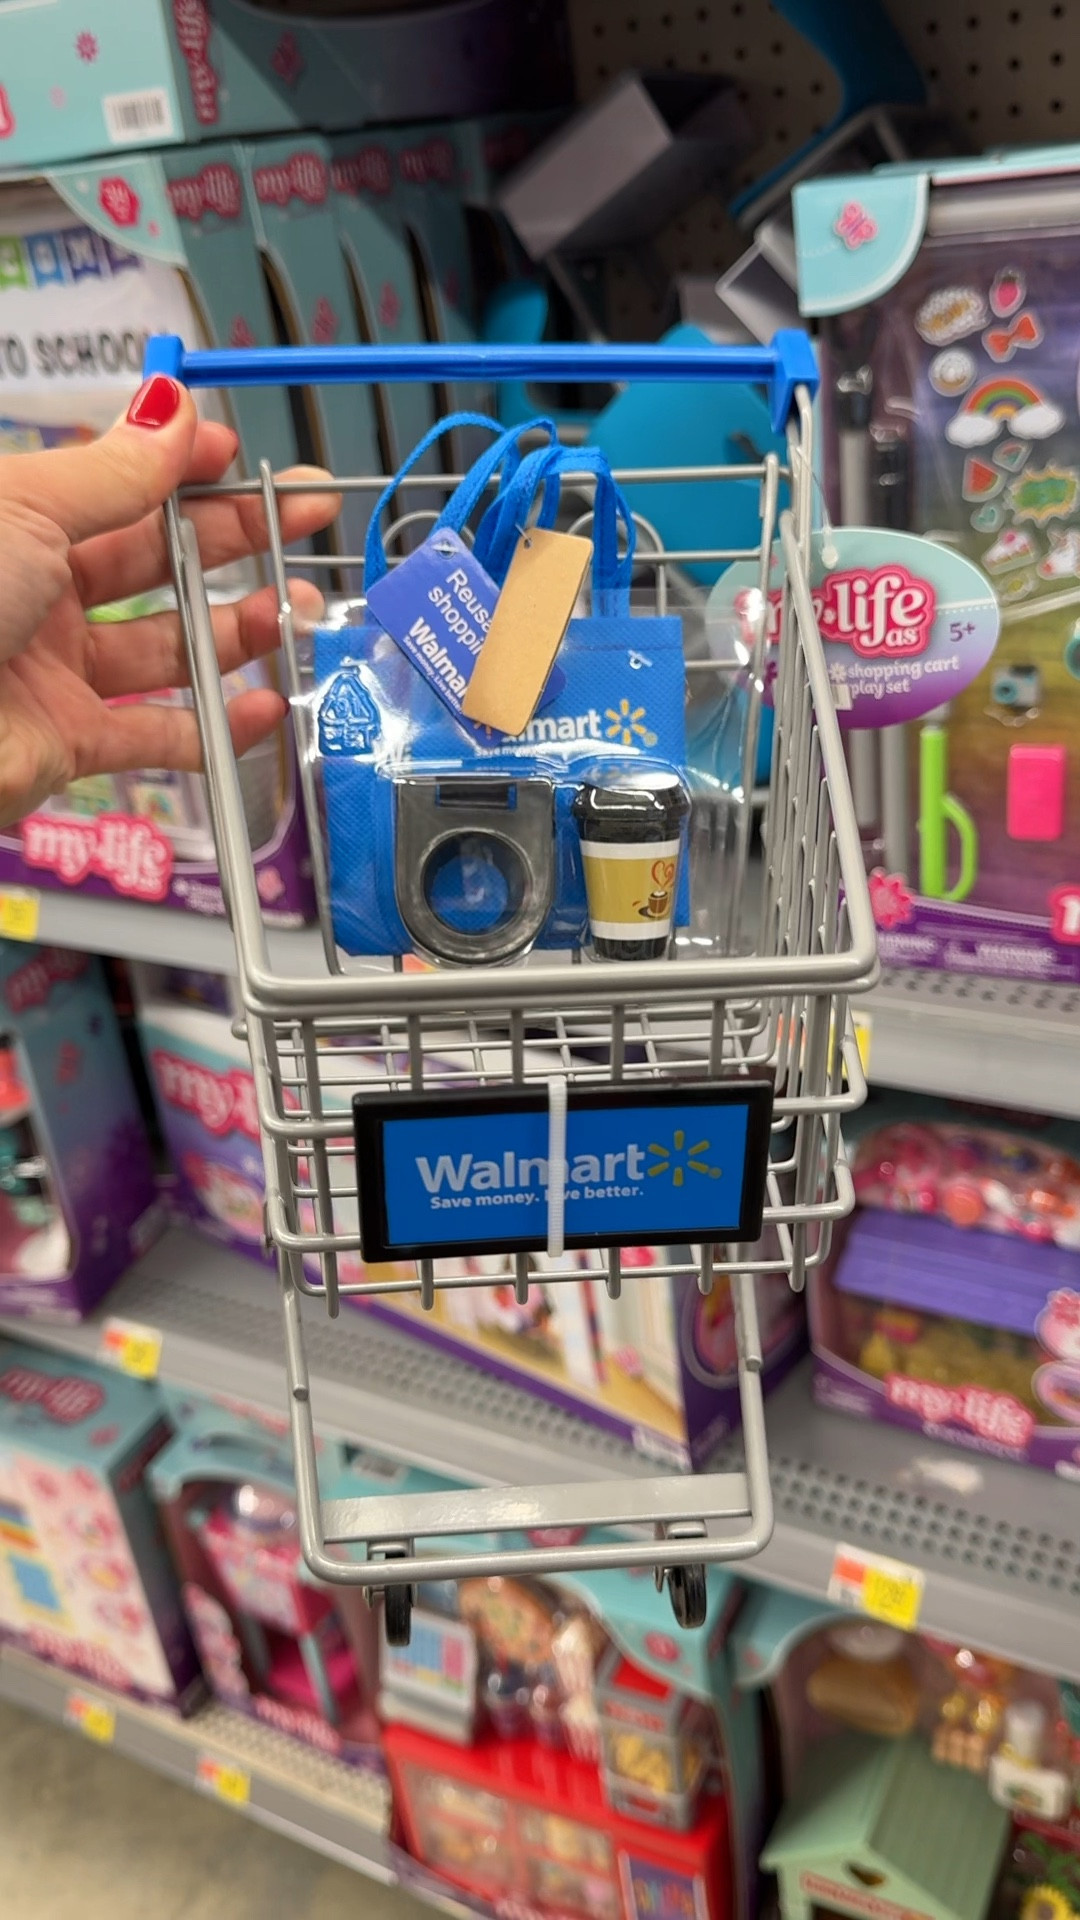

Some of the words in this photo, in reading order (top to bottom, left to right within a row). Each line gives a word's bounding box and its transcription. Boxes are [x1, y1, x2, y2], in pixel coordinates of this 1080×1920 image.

[35, 332, 147, 379] SCHOO
[832, 575, 924, 648] life
[885, 626, 918, 648] as
[949, 621, 976, 643] 5+
[848, 660, 923, 680] shopping
[924, 656, 960, 674] cart
[851, 682, 884, 700] play
[885, 679, 912, 693] set
[415, 1144, 646, 1193] Walmart
[430, 1196, 472, 1210] Save
[475, 1191, 540, 1206] money.
[584, 1185, 644, 1200] better.
